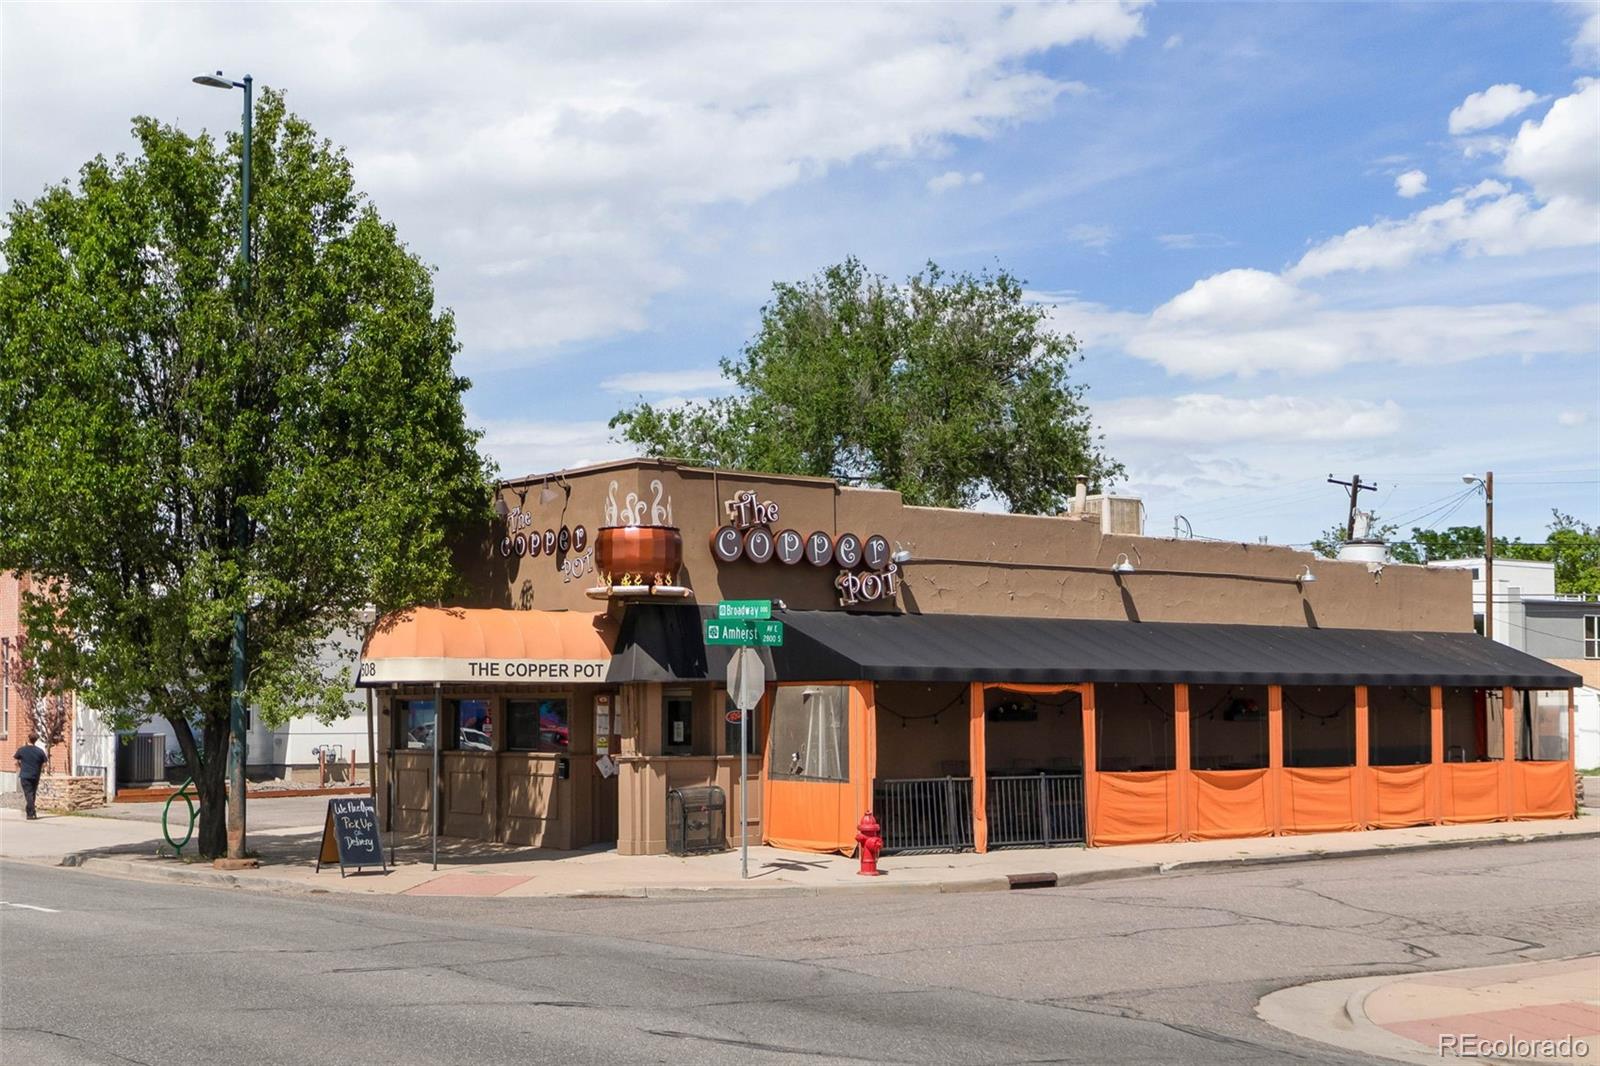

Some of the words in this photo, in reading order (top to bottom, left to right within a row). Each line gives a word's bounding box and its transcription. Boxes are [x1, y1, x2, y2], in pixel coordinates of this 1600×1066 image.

[735, 493, 779, 527] The
[508, 507, 532, 534] The
[561, 548, 593, 584] POT
[842, 563, 898, 605] POT
[726, 604, 759, 618] Broadway
[722, 625, 758, 640] Amherst
[468, 662, 500, 677] THE
[505, 663, 569, 678] COPPER
[574, 664, 604, 678] POT
[334, 802, 348, 815] We
[341, 816, 360, 830] Pick
[360, 818, 373, 832] Up
[344, 836, 375, 853] Delivery
